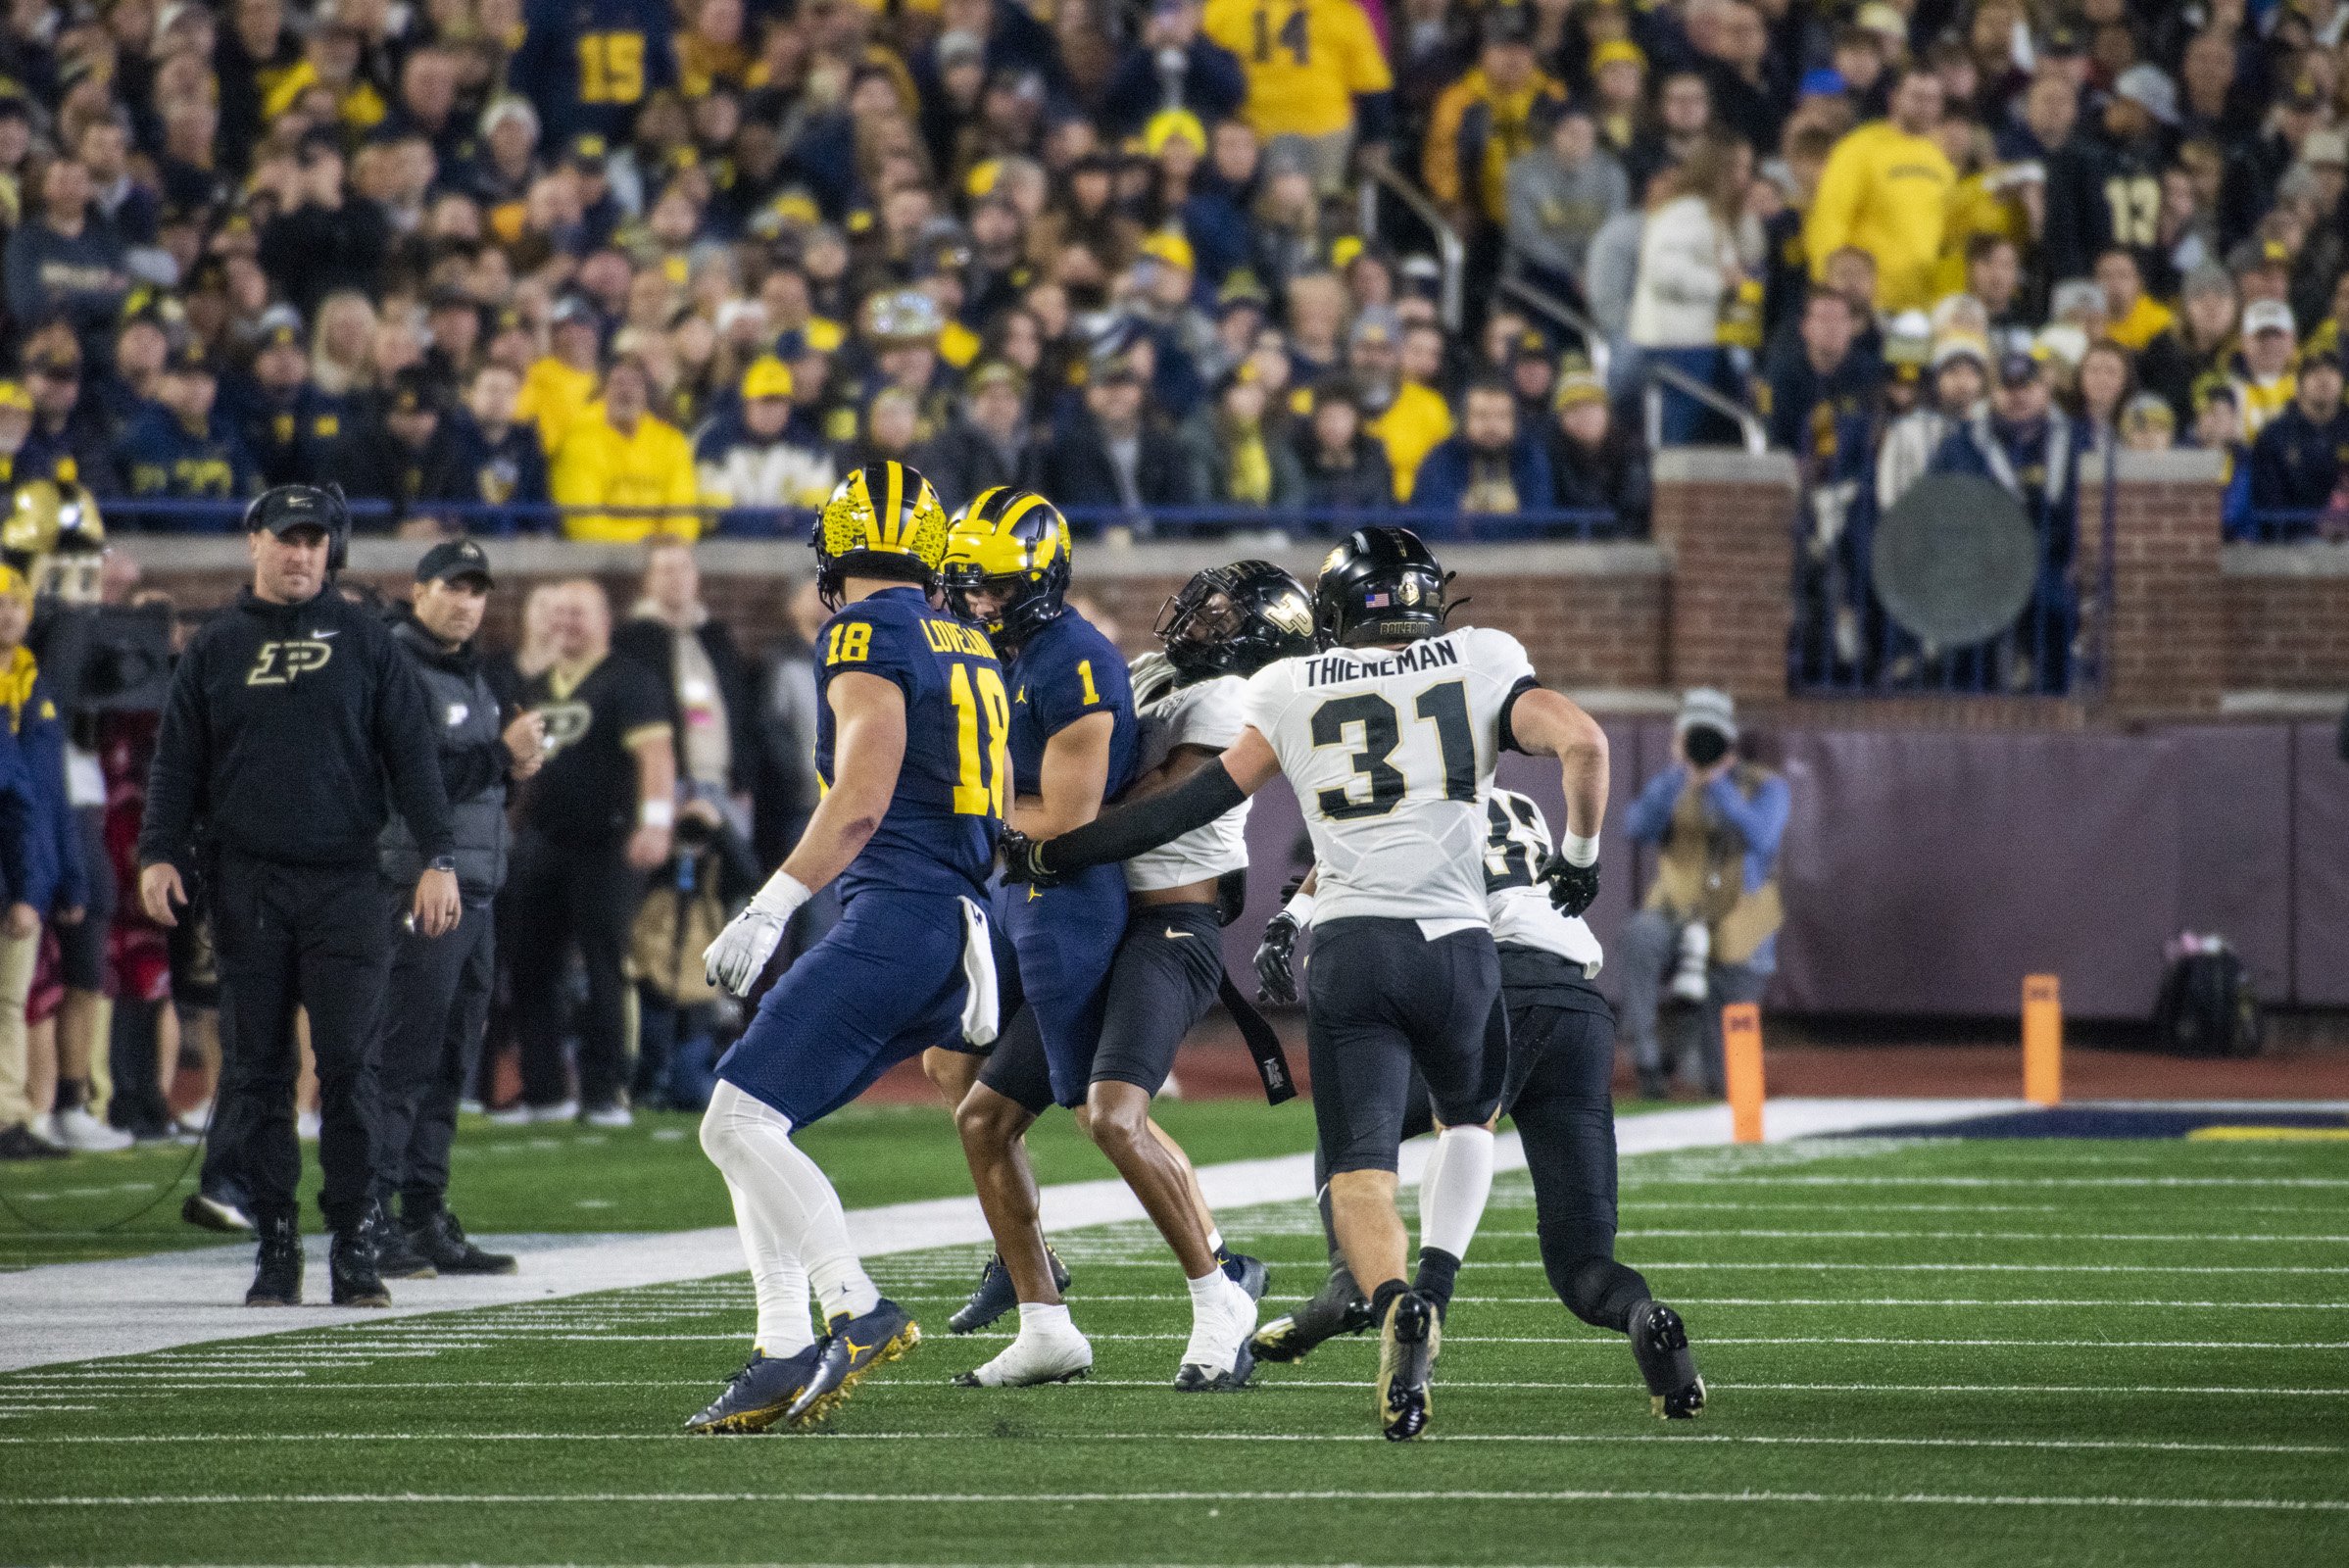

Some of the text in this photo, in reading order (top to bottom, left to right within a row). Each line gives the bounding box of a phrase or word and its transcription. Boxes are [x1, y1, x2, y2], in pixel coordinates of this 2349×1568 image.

[1252, 9, 1309, 67] 14
[826, 622, 873, 666] 18
[919, 618, 998, 660] LOVELAN
[1305, 639, 1458, 687] THIENEMAN
[1077, 660, 1100, 706] 1
[951, 662, 1010, 820] 18
[1310, 676, 1479, 824] 31
